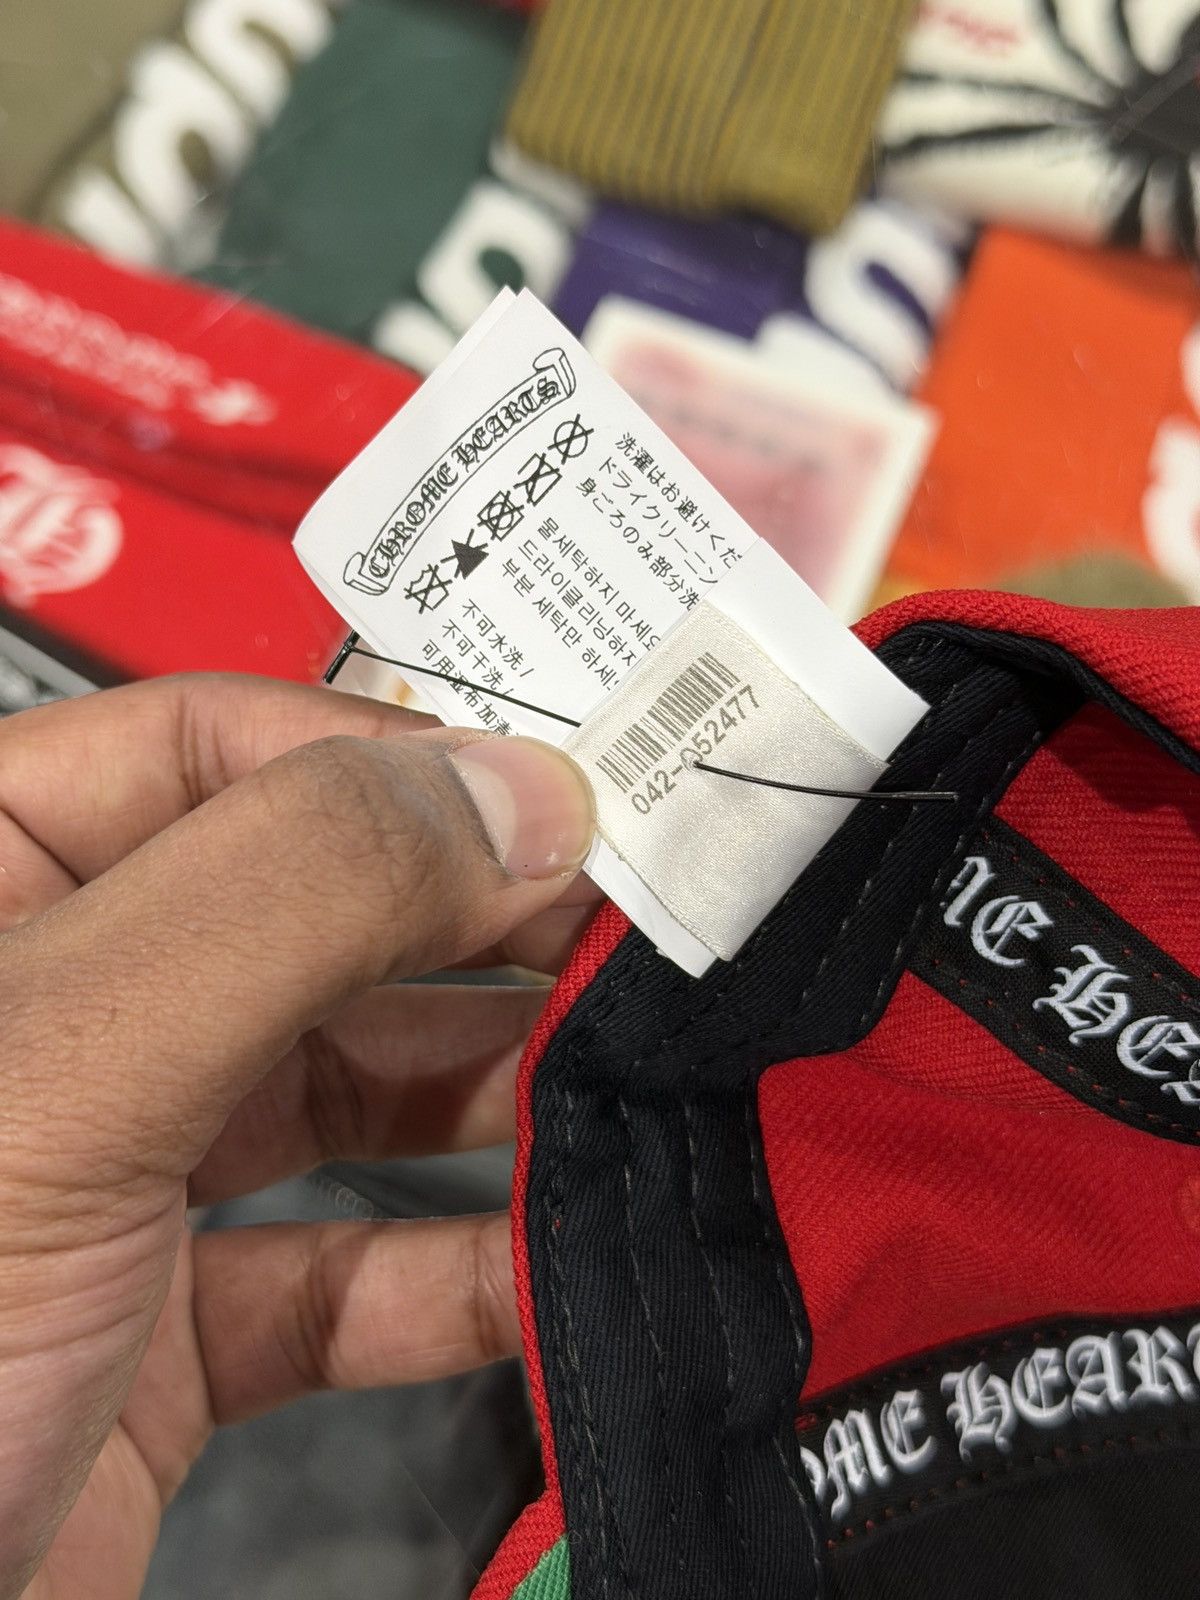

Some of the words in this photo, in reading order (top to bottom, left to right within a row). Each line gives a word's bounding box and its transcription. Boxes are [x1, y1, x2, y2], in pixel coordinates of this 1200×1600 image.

[369, 462, 459, 578] CHROME
[451, 376, 562, 473] HEARTS
[598, 457, 718, 584] ドライクリーニン
[502, 558, 535, 597] 부분
[532, 597, 583, 648] 세탁만
[581, 647, 620, 691] 하세
[537, 517, 620, 605] 물세탁하지
[631, 684, 760, 815] 042-052477
[940, 1322, 1200, 1462] HEAR
